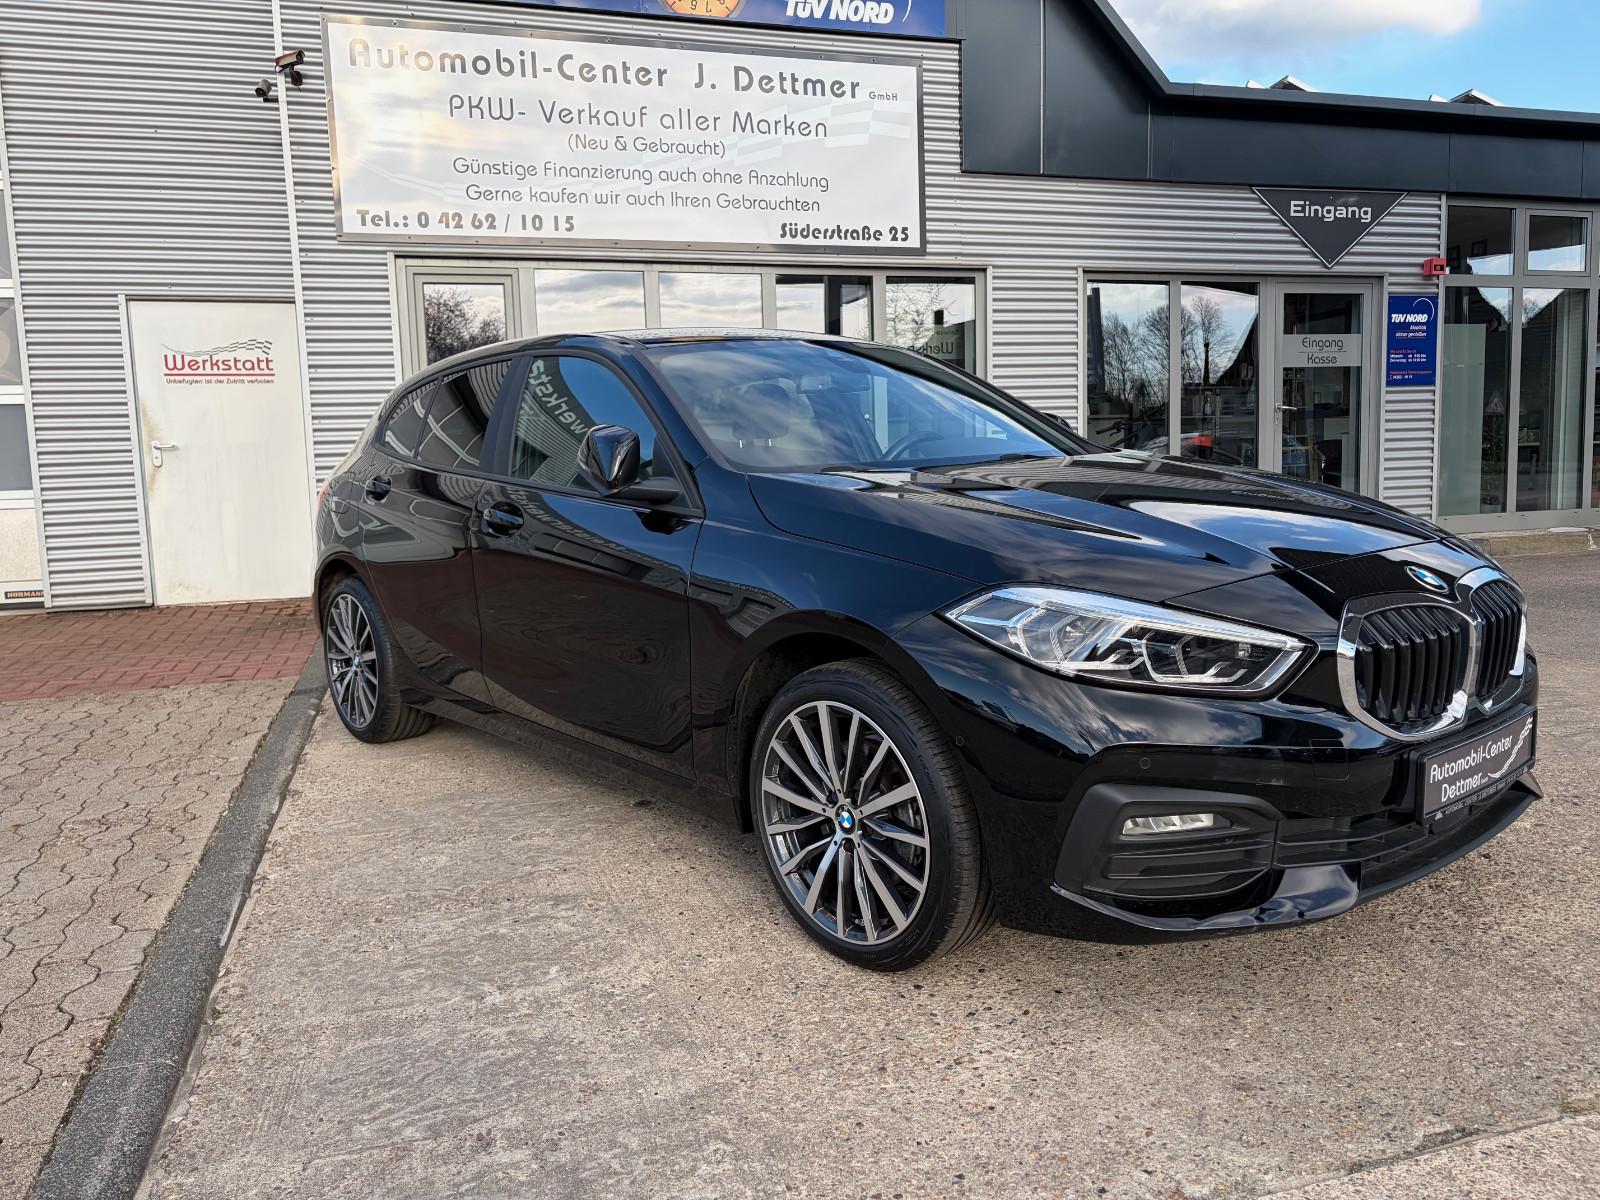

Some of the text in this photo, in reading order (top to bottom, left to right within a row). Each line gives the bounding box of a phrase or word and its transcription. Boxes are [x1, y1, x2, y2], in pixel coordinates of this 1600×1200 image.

[828, 0, 895, 25] NORD
[349, 38, 898, 102] Automobil-Center J. Dettmer GmbH
[449, 94, 828, 138] PKW- Verkauf aller Marken
[568, 133, 726, 159] (Neu & Gebraucht)
[453, 157, 829, 193] Günstige Finanzierung auch ohne Anzahlung
[465, 183, 820, 212] Gerne kaufen wir auch Ihren Gebrauchten
[356, 209, 409, 228] Tel.:
[416, 211, 430, 229] 0
[1290, 200, 1372, 223] Eingang
[779, 222, 909, 242] Süderstraße 25
[1406, 313, 1428, 323] NORD
[1301, 336, 1344, 351] Eingang
[164, 353, 275, 371] Werkstatt
[1307, 353, 1338, 365] Kasse
[1430, 735, 1513, 784] Automobil-Center
[1441, 772, 1483, 802] Dettmer
